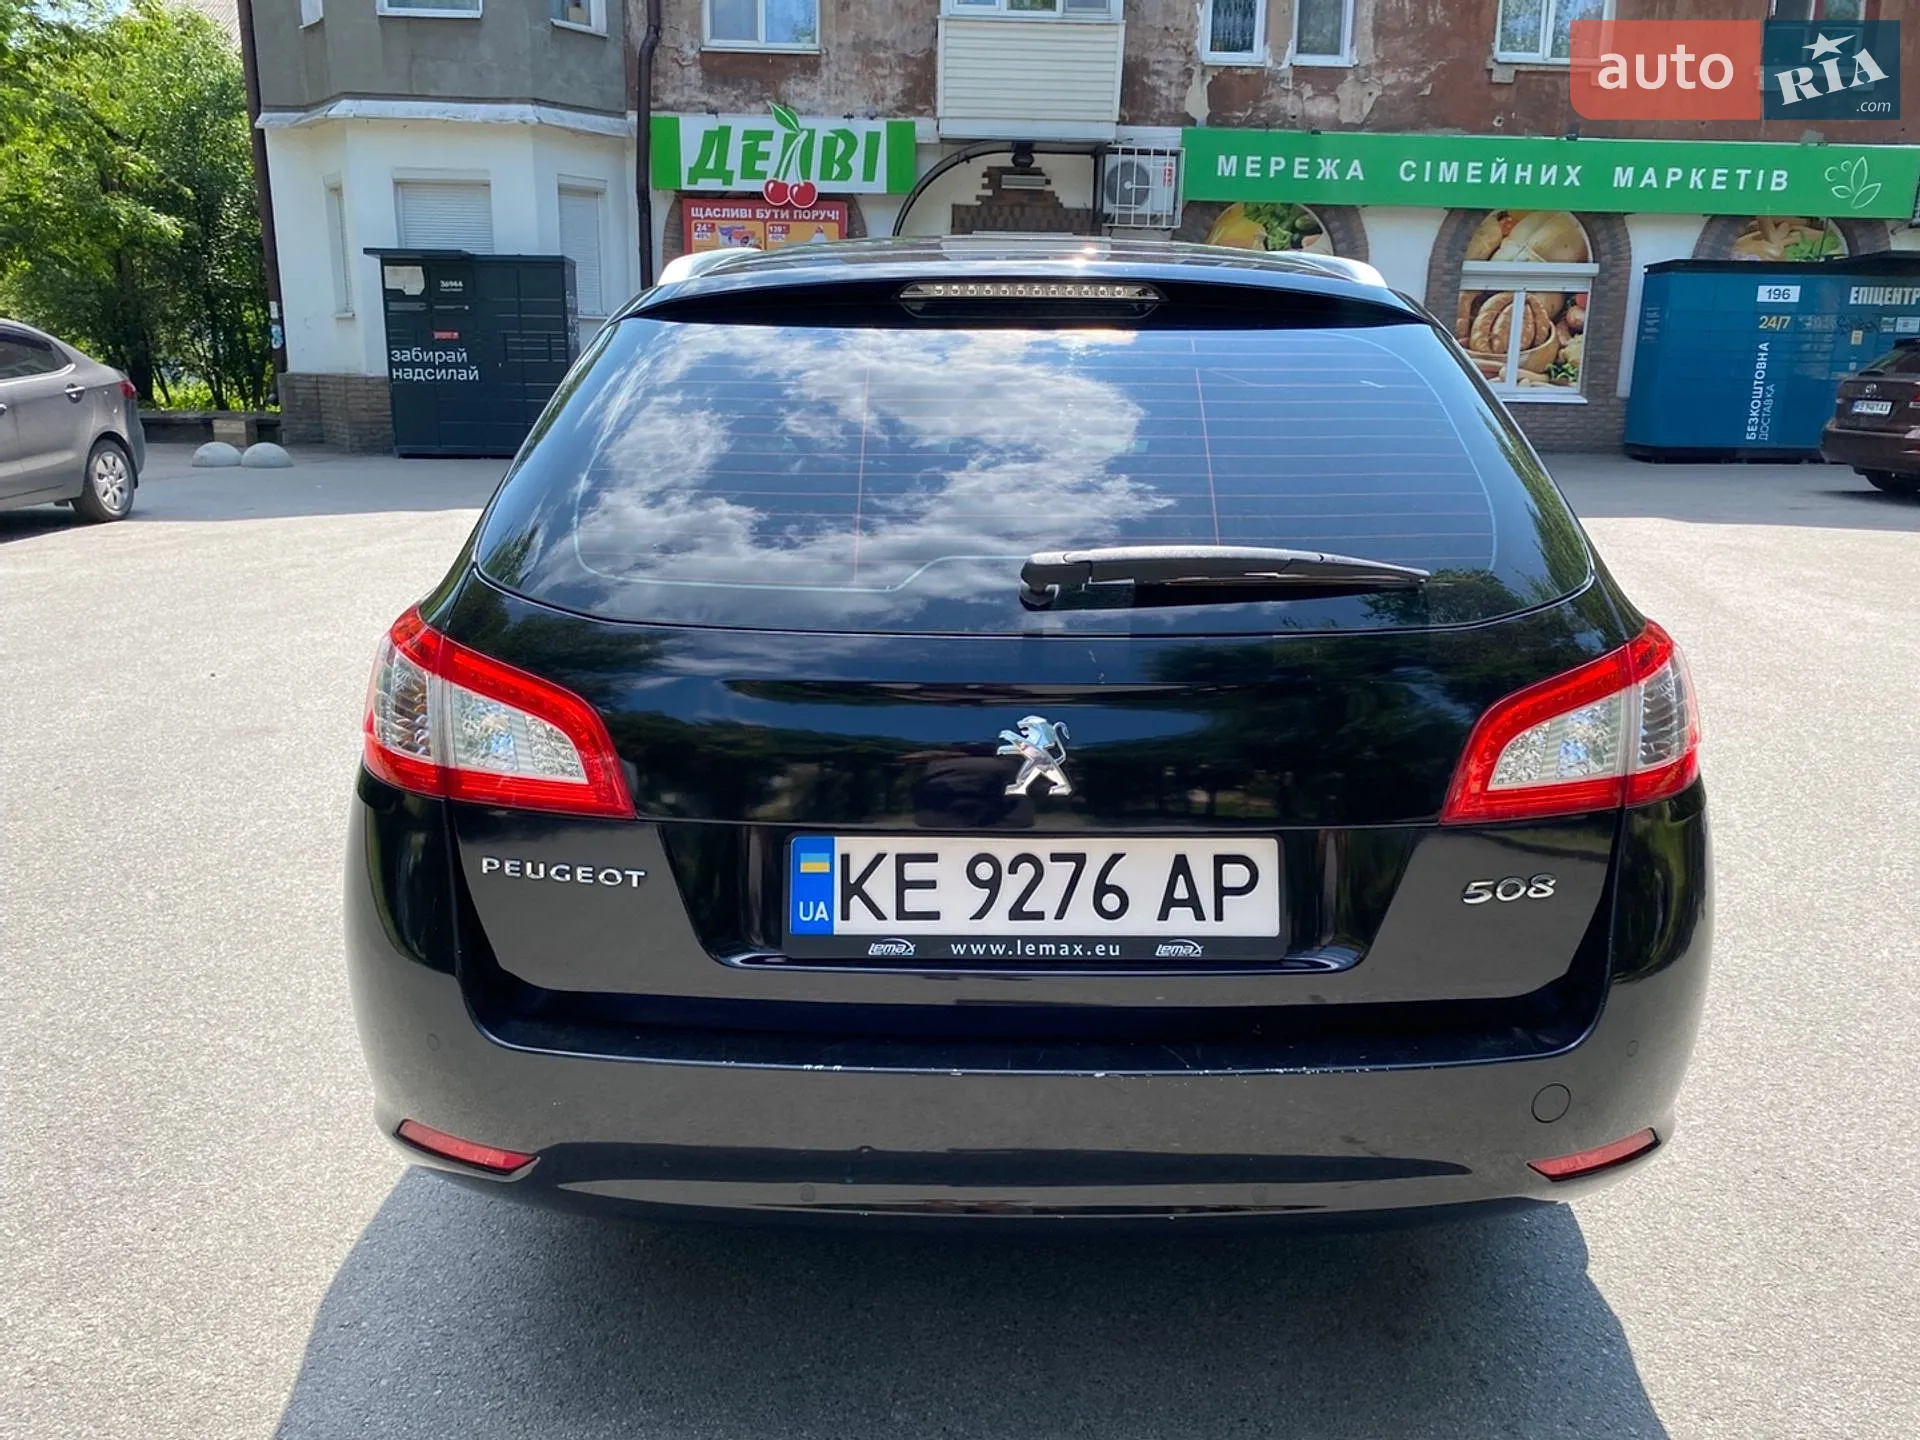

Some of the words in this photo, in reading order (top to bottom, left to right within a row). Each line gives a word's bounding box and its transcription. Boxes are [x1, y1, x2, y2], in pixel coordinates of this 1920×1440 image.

[1217, 154, 1365, 182] МЕРЕЖА
[1399, 157, 1583, 187] СІМЕЙНИХ
[1612, 165, 1790, 192] МАРКЕТІВ
[691, 206, 752, 219] ЩАСЛИВІ
[756, 208, 790, 220] БУТИ
[794, 209, 840, 221] ПОРУЧ!
[1766, 288, 1791, 301] 196
[1759, 315, 1792, 331] 24/7
[391, 347, 468, 366] забирай
[392, 366, 480, 381] надсилай
[1746, 342, 1770, 441] БЕЗКОШТОВНА
[1758, 384, 1775, 441] ДОСТАВКА
[481, 857, 646, 888] PEUGEOT
[840, 852, 942, 921] KE
[965, 853, 1130, 922] 9276
[1156, 854, 1260, 922] AP
[1462, 873, 1557, 904] 508
[799, 901, 829, 922] UA
[951, 939, 1121, 956] www.lemax.eu
